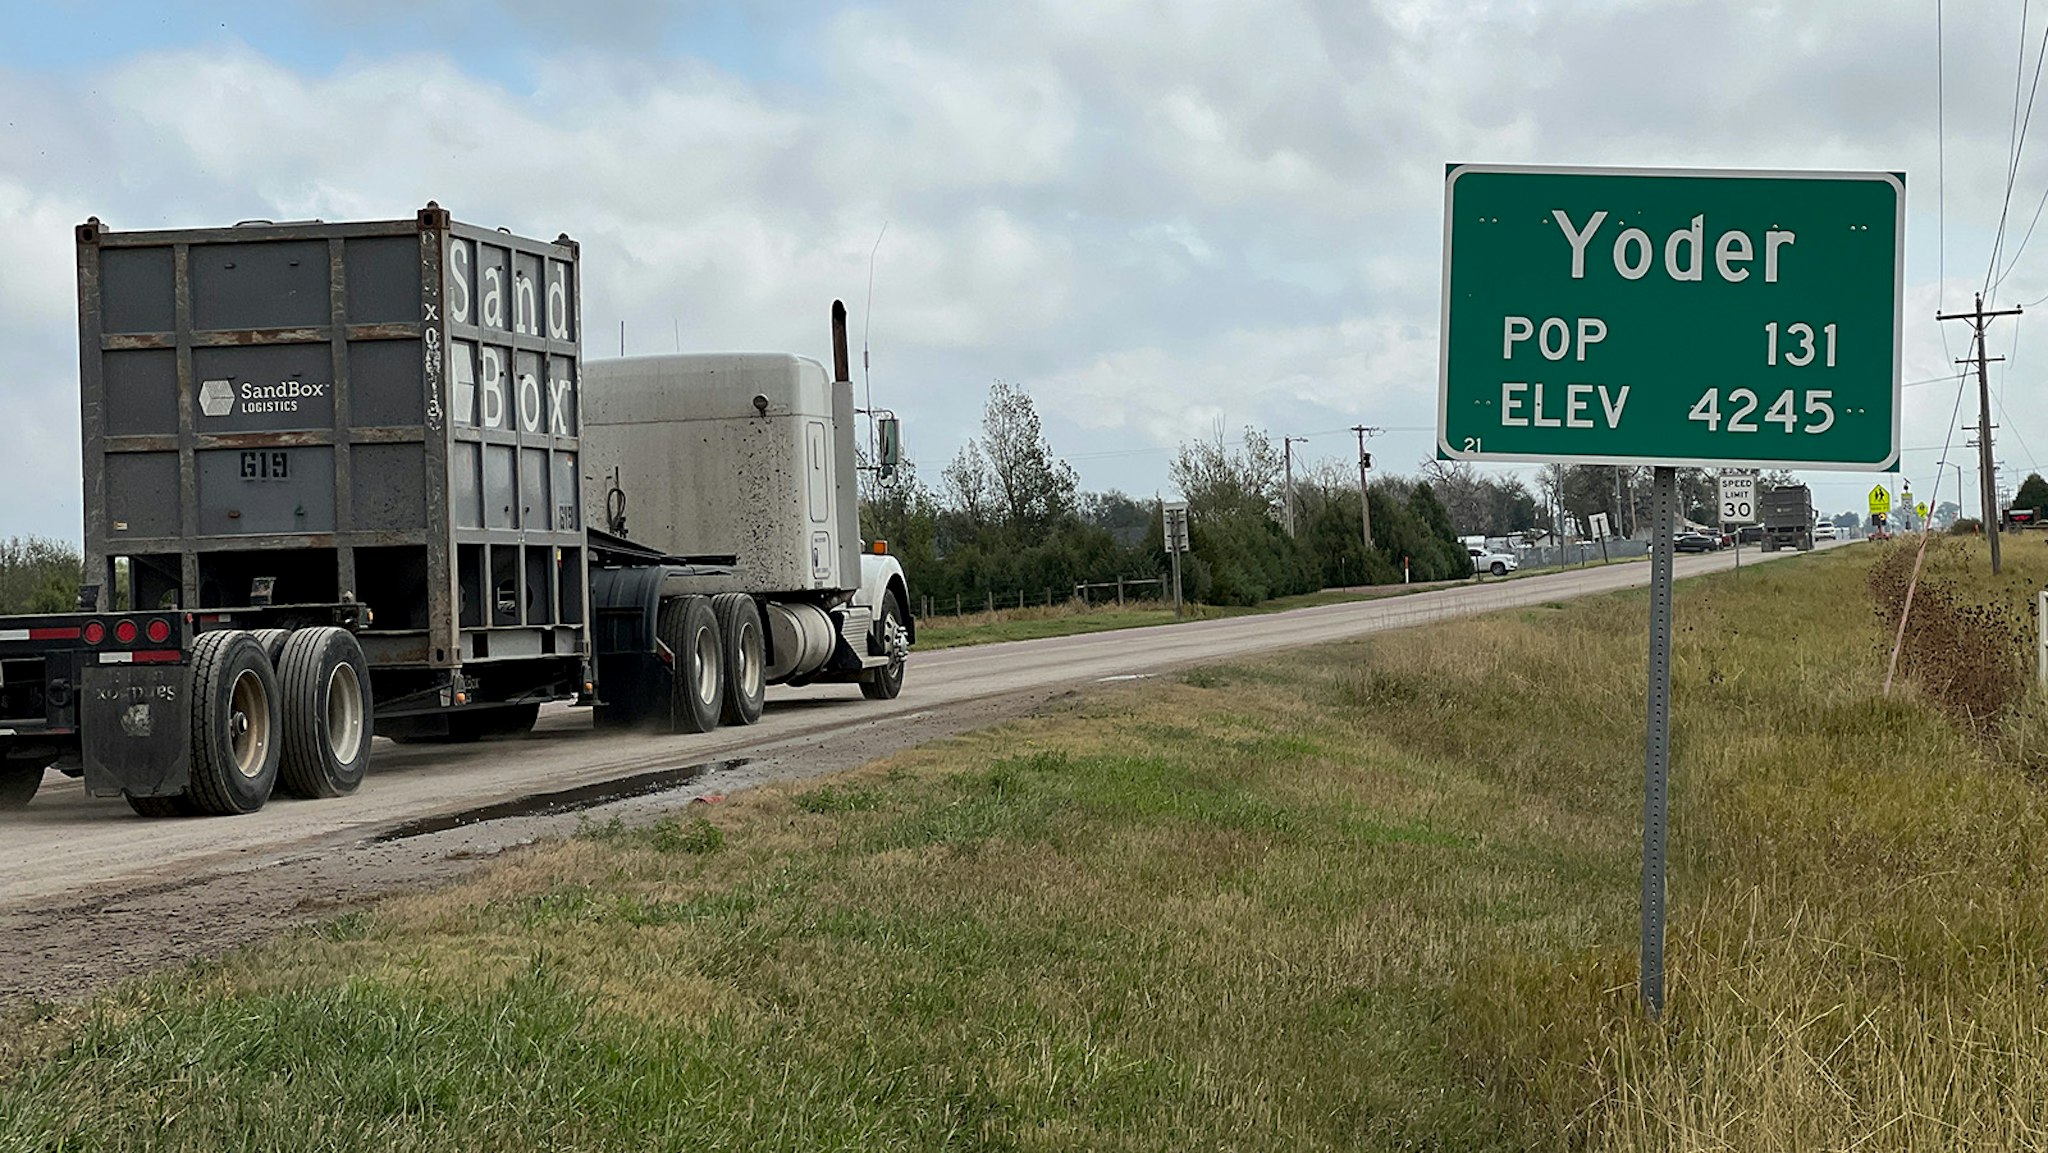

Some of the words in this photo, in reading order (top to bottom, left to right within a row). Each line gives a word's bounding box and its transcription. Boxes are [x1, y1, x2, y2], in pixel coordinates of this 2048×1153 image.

[1551, 210, 1796, 283] Yoder
[450, 238, 568, 340] Sand
[1503, 316, 1608, 361] POP
[1765, 322, 1837, 367] 131
[241, 381, 324, 399] SandBox
[482, 346, 572, 435] Box
[241, 400, 298, 413] LOGISTICS
[1501, 382, 1630, 429] ELEV
[1688, 387, 1835, 434] 4245
[1463, 436, 1481, 453] 21
[240, 451, 288, 478] G19
[1722, 480, 1752, 488] SPEED
[1725, 491, 1748, 499] LIMIT
[1723, 502, 1751, 517] 30
